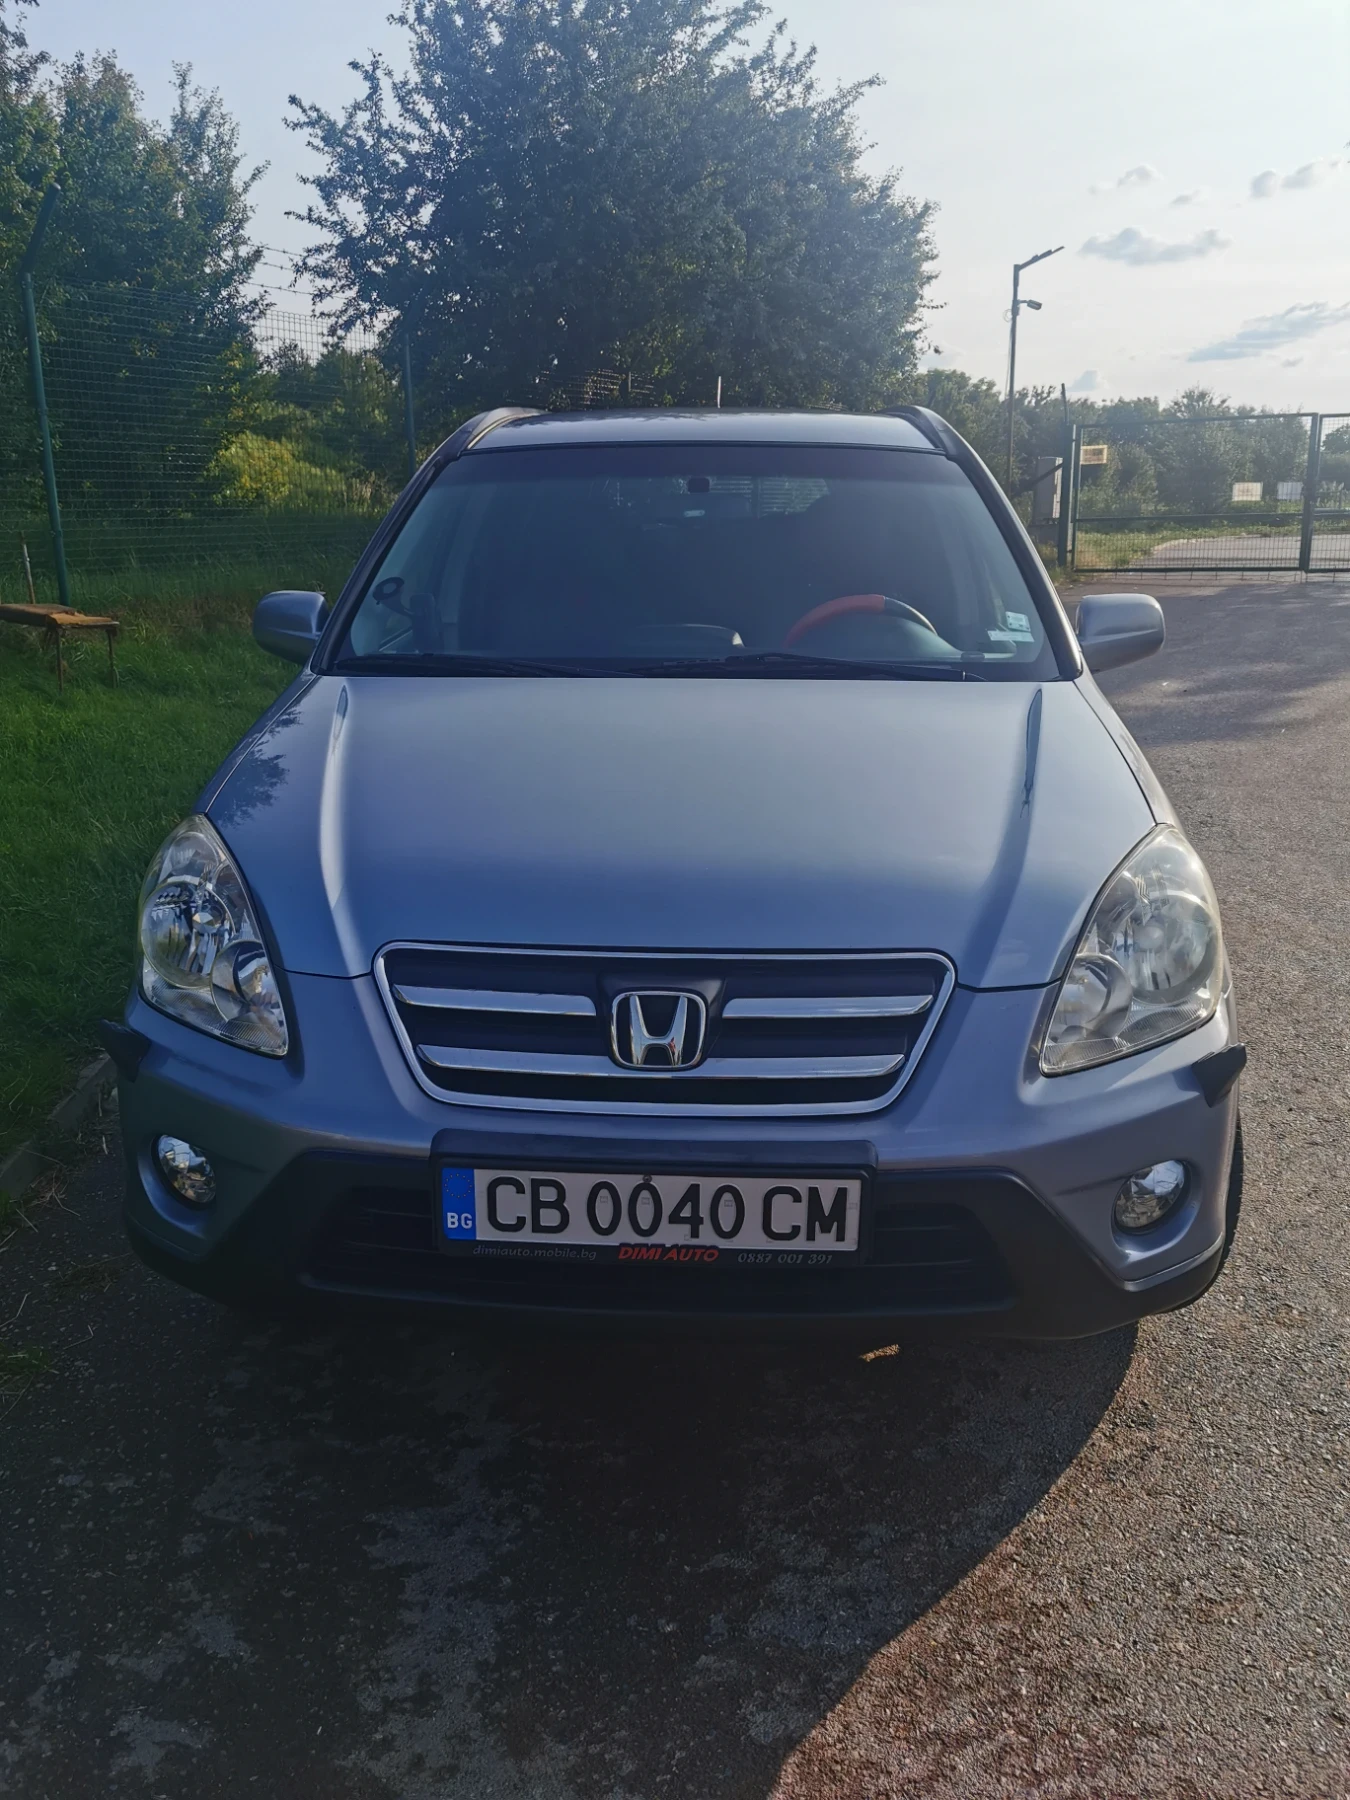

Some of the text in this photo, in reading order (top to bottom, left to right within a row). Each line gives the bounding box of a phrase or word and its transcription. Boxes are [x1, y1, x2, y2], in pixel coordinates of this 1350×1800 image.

[486, 1176, 849, 1242] CB 0040 CM
[447, 1213, 473, 1229] BG
[472, 1245, 597, 1260] dimiauto.mobile.bg
[618, 1246, 719, 1262] DIMI AUTO
[737, 1252, 833, 1265] 0887 001 391
